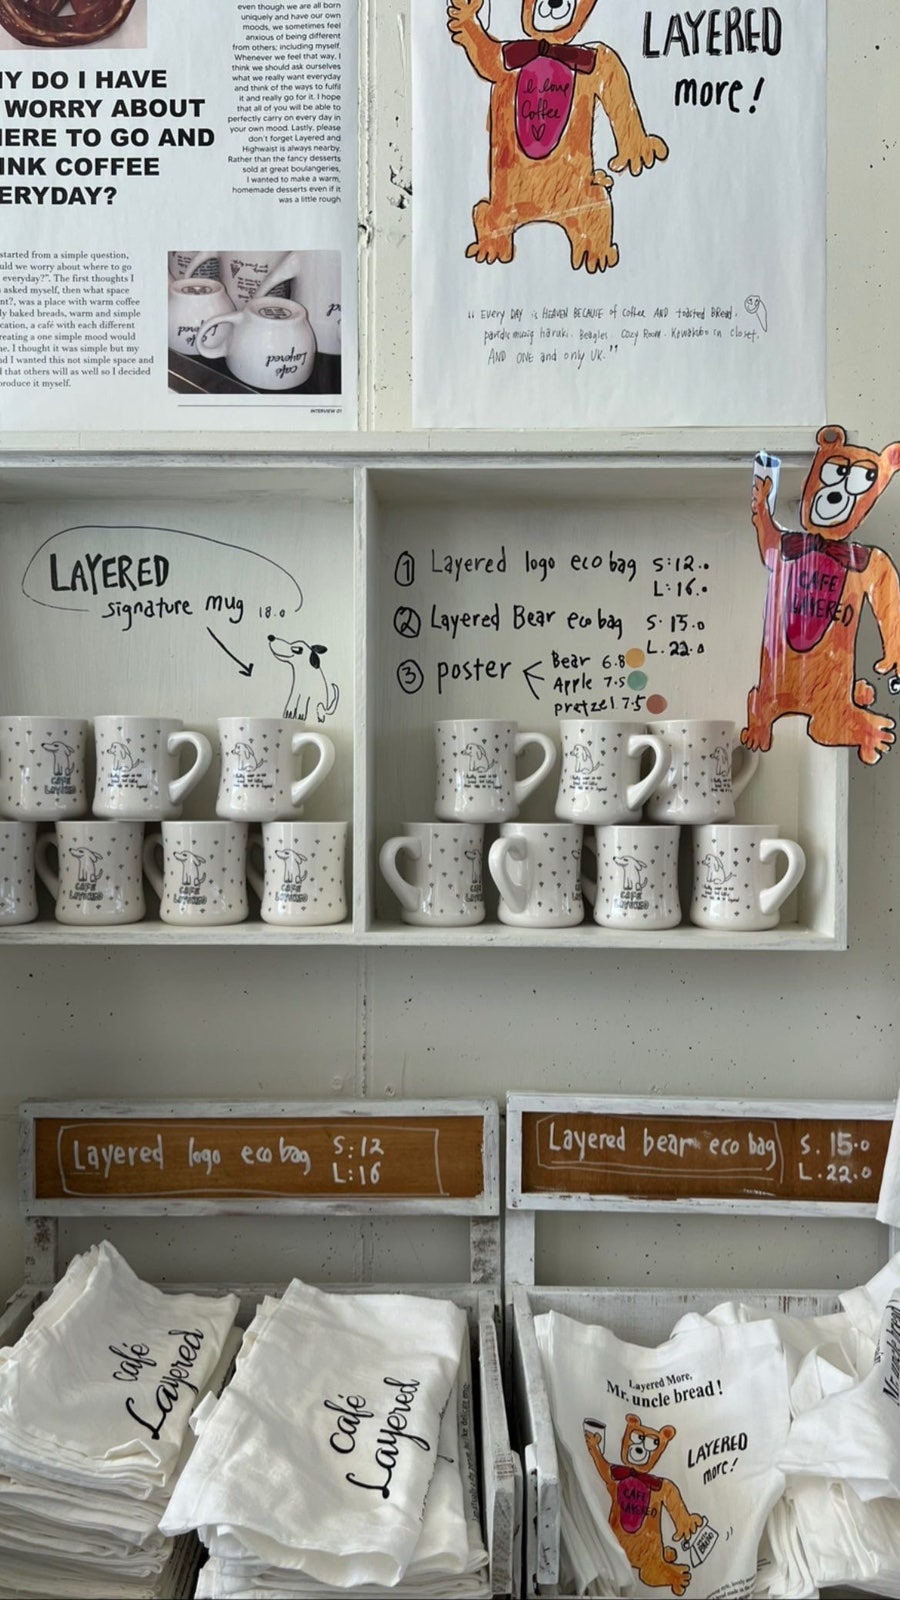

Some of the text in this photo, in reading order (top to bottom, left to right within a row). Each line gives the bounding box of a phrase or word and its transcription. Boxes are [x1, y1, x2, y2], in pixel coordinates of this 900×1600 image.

[245, 31, 340, 42] anxious of being different
[643, 6, 782, 58] LAYERED
[231, 64, 250, 72] think
[264, 63, 289, 72] should
[291, 63, 304, 71] ask
[305, 62, 341, 71] ourselves
[0, 70, 167, 89] Y DO I HAVE
[4, 99, 205, 118] WORRY ABOUT
[0, 128, 214, 147] ERE TO GO AND
[270, 134, 292, 144] forget
[294, 134, 324, 144] Layered
[326, 133, 341, 142] and
[56, 158, 159, 176] COFFEE
[232, 185, 274, 194] homemade
[275, 185, 307, 193] desserts
[328, 184, 334, 193] if
[335, 184, 341, 193] it
[300, 195, 317, 204] little
[318, 195, 341, 205] rough
[31, 249, 51, 259] from
[60, 249, 88, 262] simple
[90, 249, 128, 262] question,
[14, 263, 27, 271] we
[29, 263, 55, 273] worry
[56, 260, 80, 271] about
[82, 260, 108, 271] where
[110, 260, 119, 271] to
[121, 263, 132, 273] go
[53, 272, 70, 282] The
[72, 272, 89, 282] first
[91, 272, 128, 285] thoughts
[130, 272, 134, 282] I
[573, 306, 604, 319] BECAUSE
[609, 304, 617, 319] of
[653, 307, 669, 318] AND
[488, 347, 506, 365] AND
[516, 351, 534, 364] ONE
[540, 348, 557, 363] and
[564, 349, 586, 370] only
[50, 553, 169, 595] LAYERED
[432, 546, 506, 582] Layered
[526, 551, 555, 582] logo
[571, 555, 602, 571] eco
[609, 551, 636, 582] bag
[800, 571, 838, 592] CAFE
[102, 597, 193, 631] signature
[205, 595, 243, 624] mug
[431, 603, 499, 639] Layered
[513, 605, 556, 629] Bear
[567, 612, 592, 629] eco
[598, 608, 622, 640] bag
[552, 650, 625, 669] Bear 6.8
[438, 658, 512, 694] poster
[553, 672, 626, 696] Apple 7.5
[622, 695, 646, 711] 7.5
[74, 1134, 163, 1178] Layered
[188, 1137, 221, 1175] logo
[241, 1145, 272, 1164] eco
[280, 1137, 311, 1174] bag
[550, 1121, 626, 1162] Layered
[643, 1127, 697, 1157] bear
[709, 1137, 740, 1156] eco
[749, 1131, 777, 1171] bag
[109, 1342, 157, 1382] café
[124, 1329, 206, 1442] Layered
[606, 1380, 630, 1402] Mr.
[632, 1391, 670, 1408] uncle
[628, 1378, 665, 1393] Layered
[324, 1394, 374, 1454] café
[344, 1377, 432, 1501] Layered
[687, 1432, 748, 1468] LAYERED
